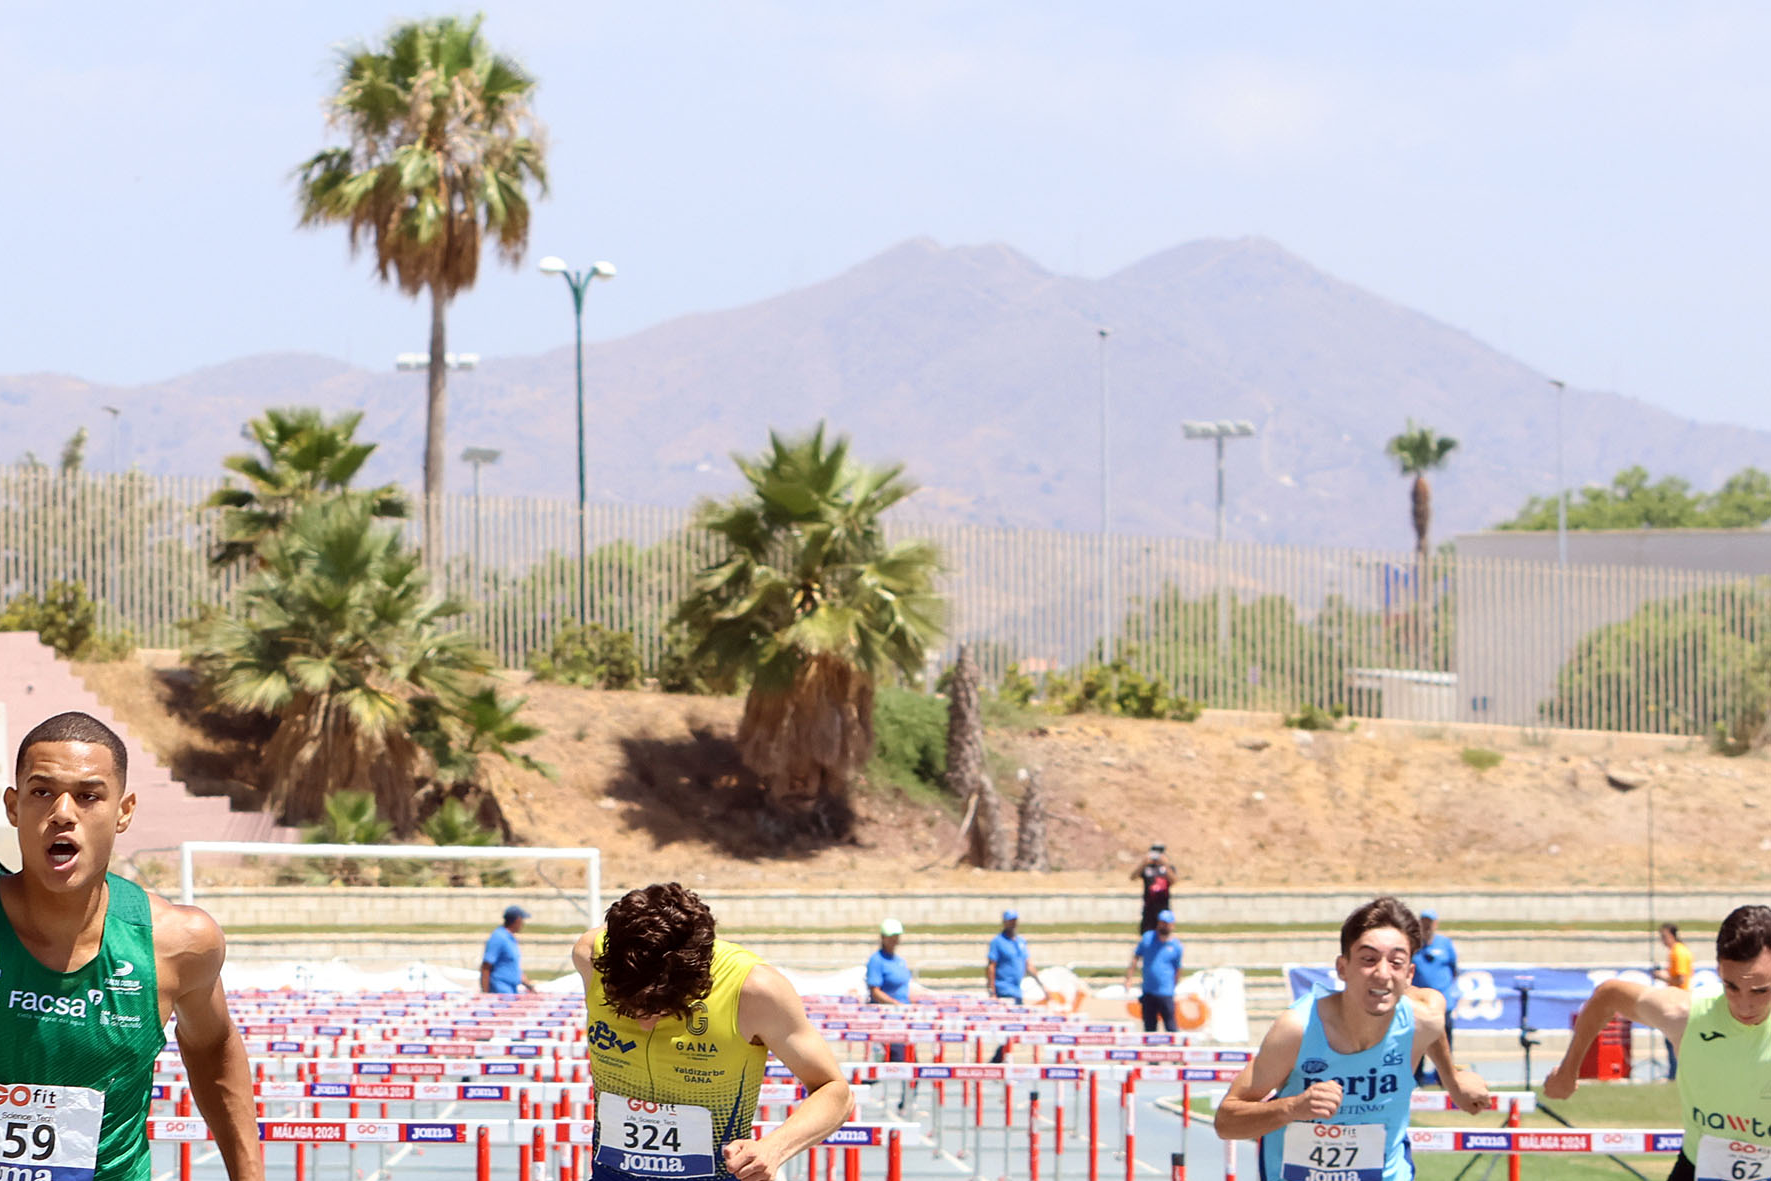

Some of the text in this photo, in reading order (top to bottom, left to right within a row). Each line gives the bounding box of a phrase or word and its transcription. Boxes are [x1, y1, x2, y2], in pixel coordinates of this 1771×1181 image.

[675, 1041, 719, 1053] GANA
[684, 1075, 712, 1084] GANA
[389, 1085, 411, 1098] 2024
[272, 1123, 315, 1138] MÁLAGA
[315, 1125, 341, 1139] 2024
[411, 1126, 453, 1139] Joma
[622, 1122, 682, 1152] 324
[1466, 1134, 1508, 1148] Joma
[1518, 1134, 1559, 1149] MÁLAGA
[1560, 1135, 1586, 1149] 2024
[619, 1152, 686, 1173] Joma
[1308, 1147, 1359, 1168] 427
[1731, 1160, 1763, 1180] 62
